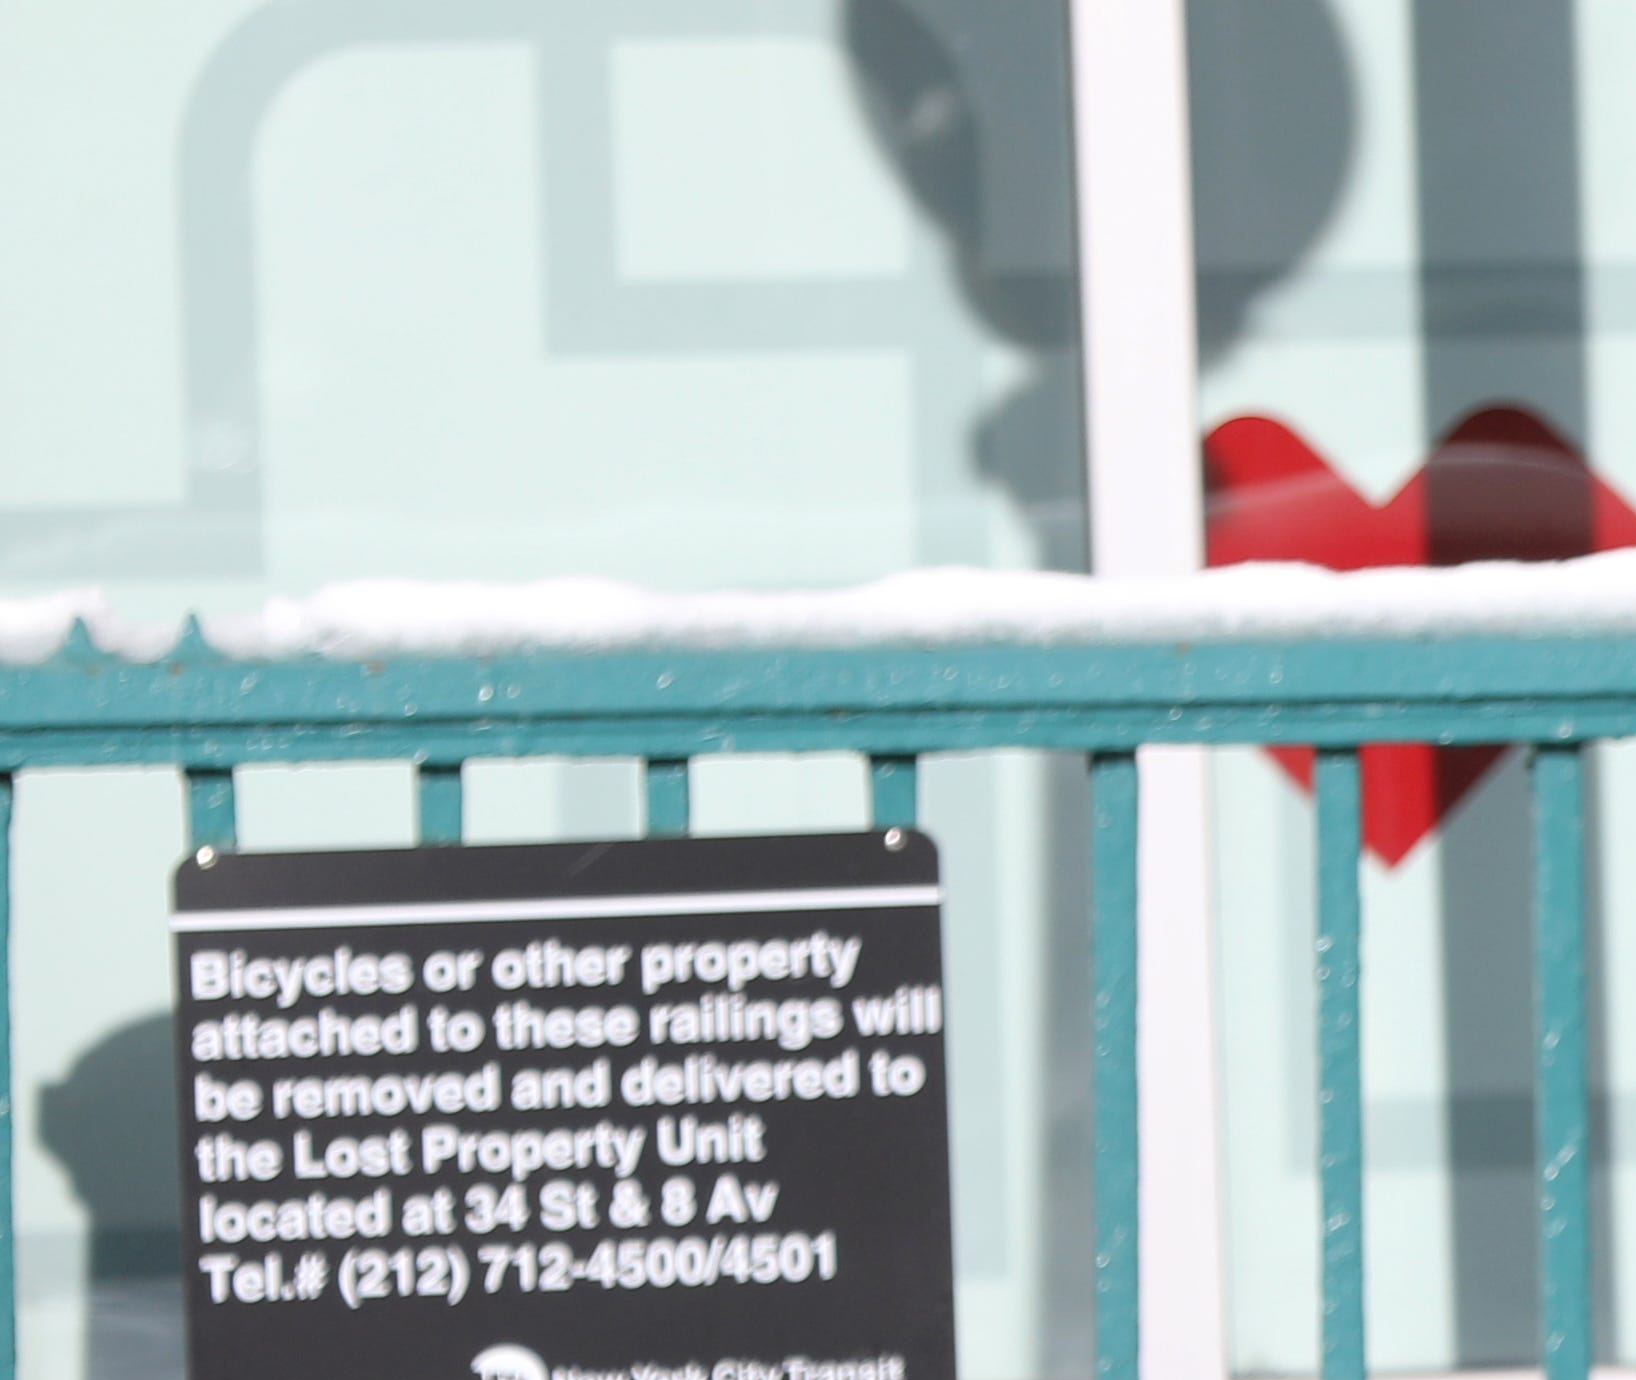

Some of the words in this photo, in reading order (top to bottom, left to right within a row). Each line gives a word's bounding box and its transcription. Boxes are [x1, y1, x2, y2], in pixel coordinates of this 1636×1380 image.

[190, 946, 414, 1009] Bicycles
[422, 951, 483, 992] or
[491, 939, 632, 990] other
[641, 931, 861, 995] property
[191, 1005, 418, 1062] attached
[426, 1006, 485, 1053] to
[492, 1001, 639, 1050] these
[649, 993, 843, 1051] railings
[852, 985, 943, 1036] will
[194, 1073, 262, 1122] be
[272, 1062, 501, 1119] removed
[510, 1058, 611, 1111] and
[620, 1049, 860, 1107] delivered
[868, 1050, 926, 1097] to
[194, 1133, 283, 1182] the
[293, 1129, 411, 1179] Lost
[421, 1121, 646, 1182] Property
[656, 1114, 765, 1166] Unit
[199, 1188, 392, 1243] located
[401, 1188, 455, 1236] at
[464, 1182, 529, 1234] 34
[539, 1180, 597, 1231] St
[608, 1178, 649, 1228] &
[660, 1176, 697, 1227] 8
[706, 1174, 780, 1224] Av
[198, 1253, 328, 1304] Tel.#
[338, 1248, 470, 1309] (212)
[477, 1232, 836, 1294] 712-4500/4501
